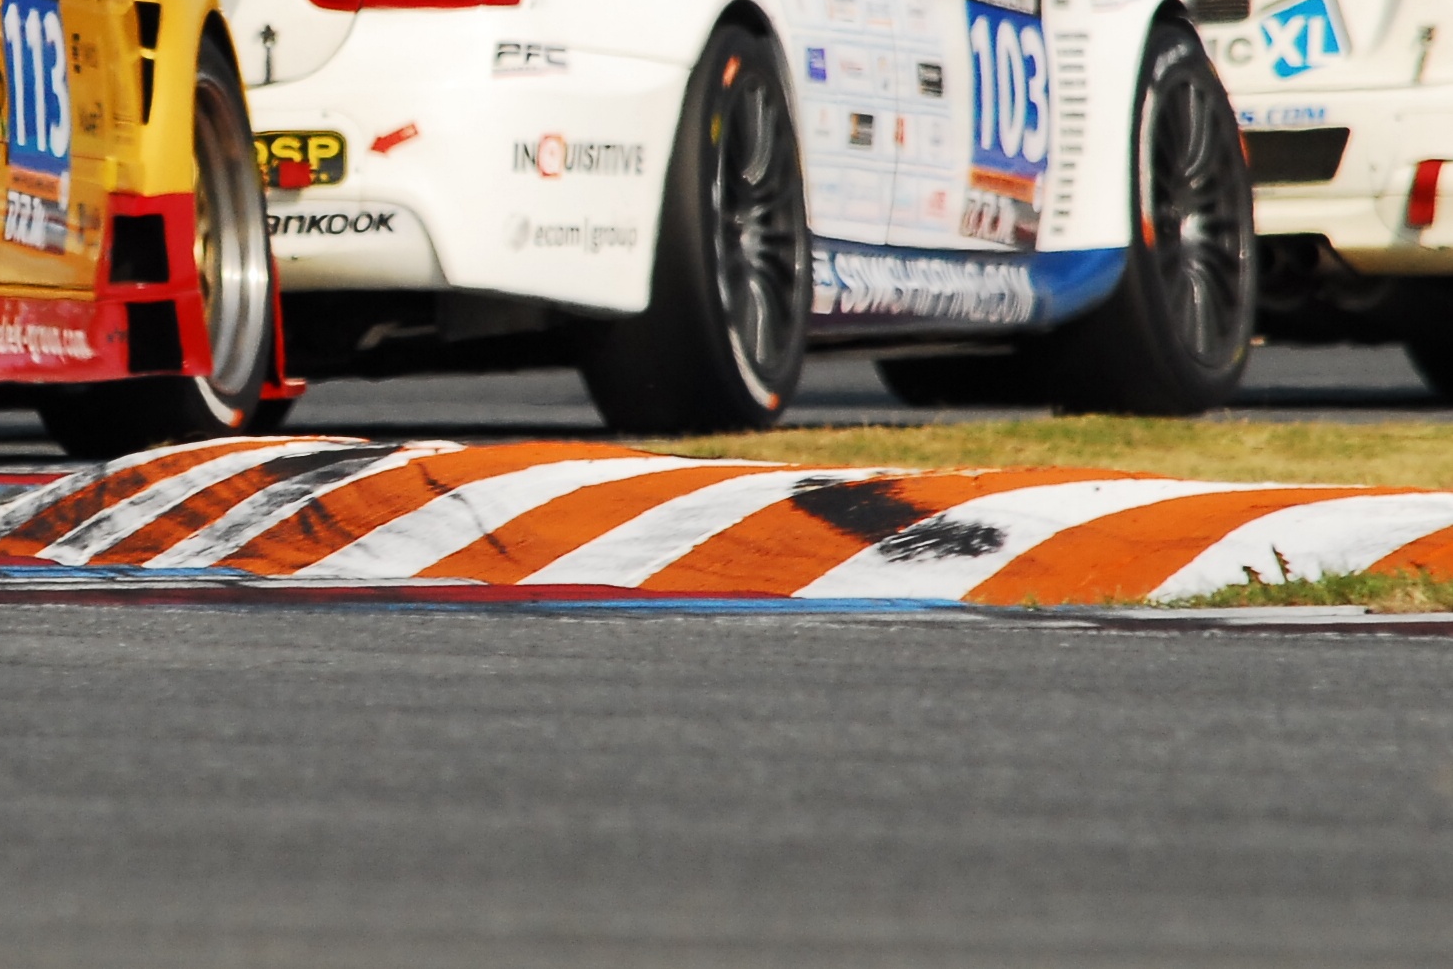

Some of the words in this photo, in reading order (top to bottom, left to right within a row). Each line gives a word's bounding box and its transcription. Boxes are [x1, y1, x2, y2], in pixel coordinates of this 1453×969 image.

[4, 2, 71, 159] 113
[970, 14, 1049, 164] 103
[1260, 14, 1340, 67] XL
[513, 134, 644, 178] INQUISITIVE
